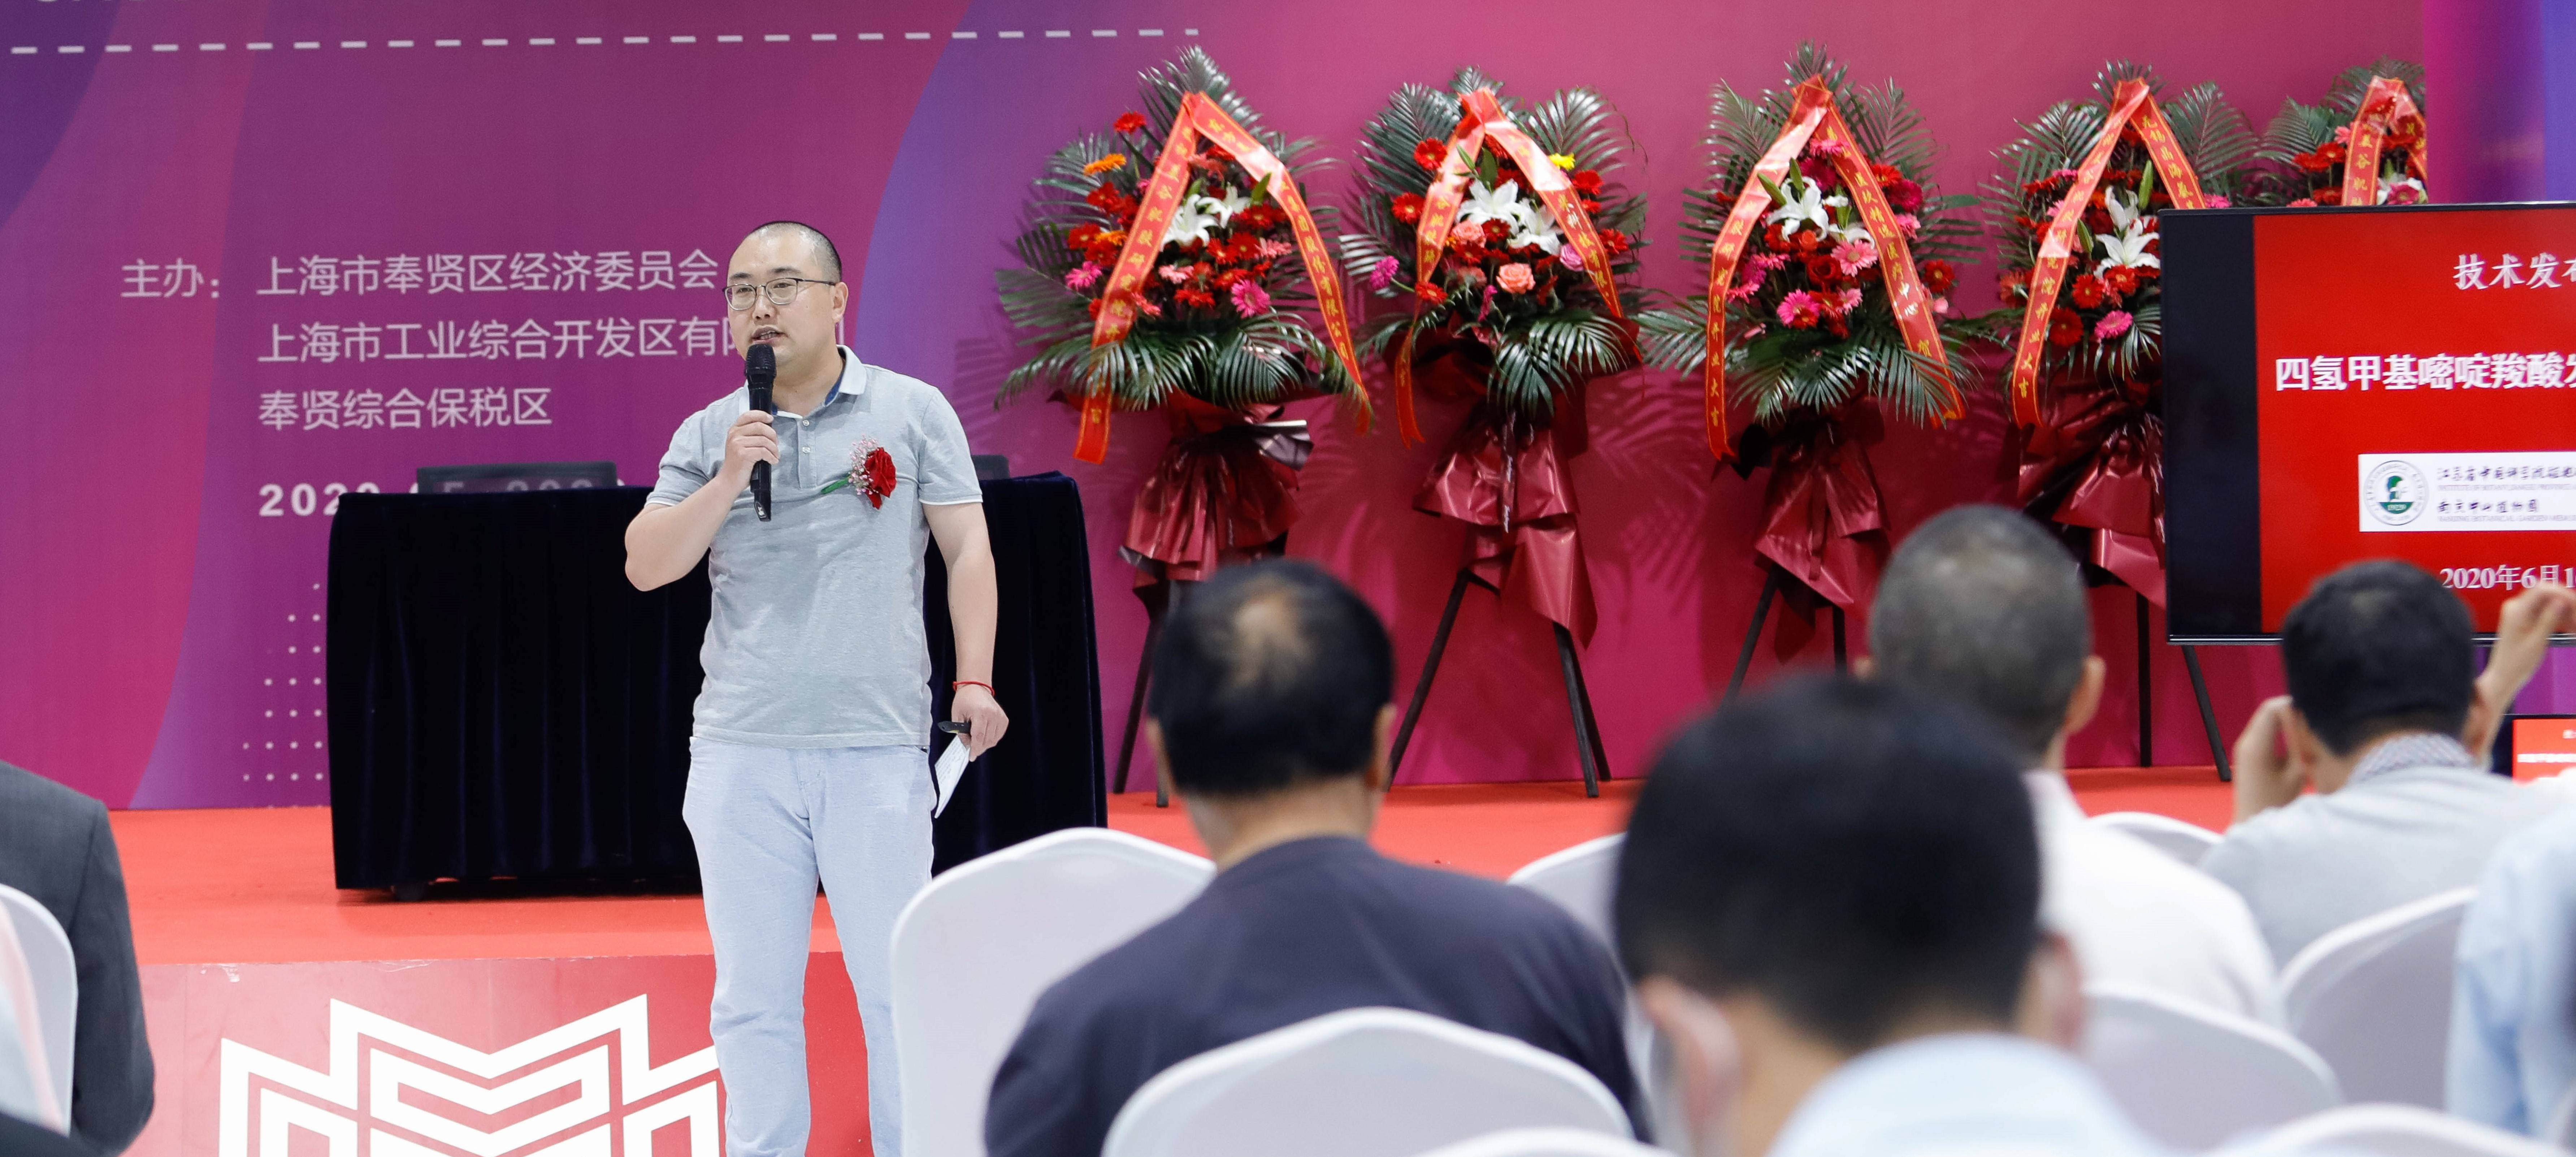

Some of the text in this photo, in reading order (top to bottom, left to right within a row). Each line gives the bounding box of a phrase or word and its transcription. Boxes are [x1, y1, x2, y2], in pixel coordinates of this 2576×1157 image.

[257, 249, 718, 295] 上海市奉贤区经济委员会
[259, 387, 552, 431] 奉贤综合保税区
[2439, 564, 2576, 590] 2020年6月1
